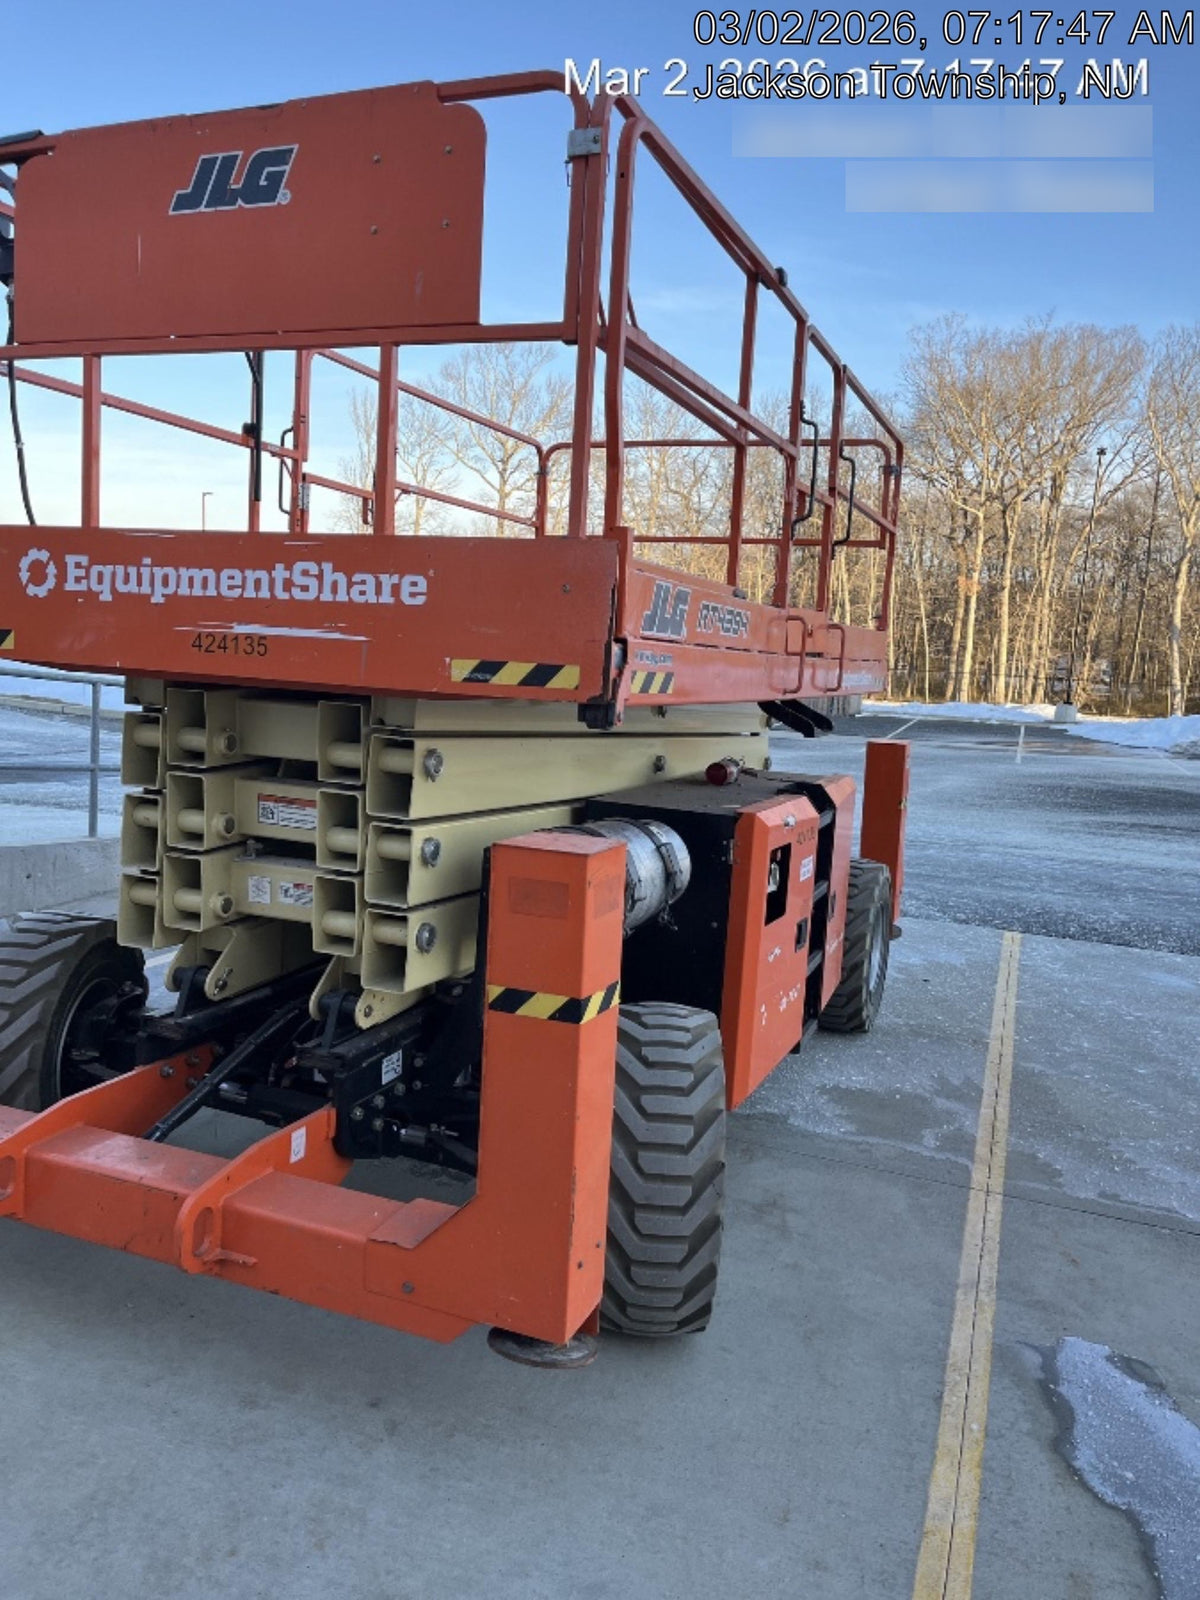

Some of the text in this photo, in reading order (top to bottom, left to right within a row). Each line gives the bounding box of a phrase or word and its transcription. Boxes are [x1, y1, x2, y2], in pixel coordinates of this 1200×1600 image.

[168, 143, 299, 215] JLG
[64, 554, 428, 606] EquipmentShare
[640, 580, 692, 639] JLG
[191, 632, 268, 657] 424135
